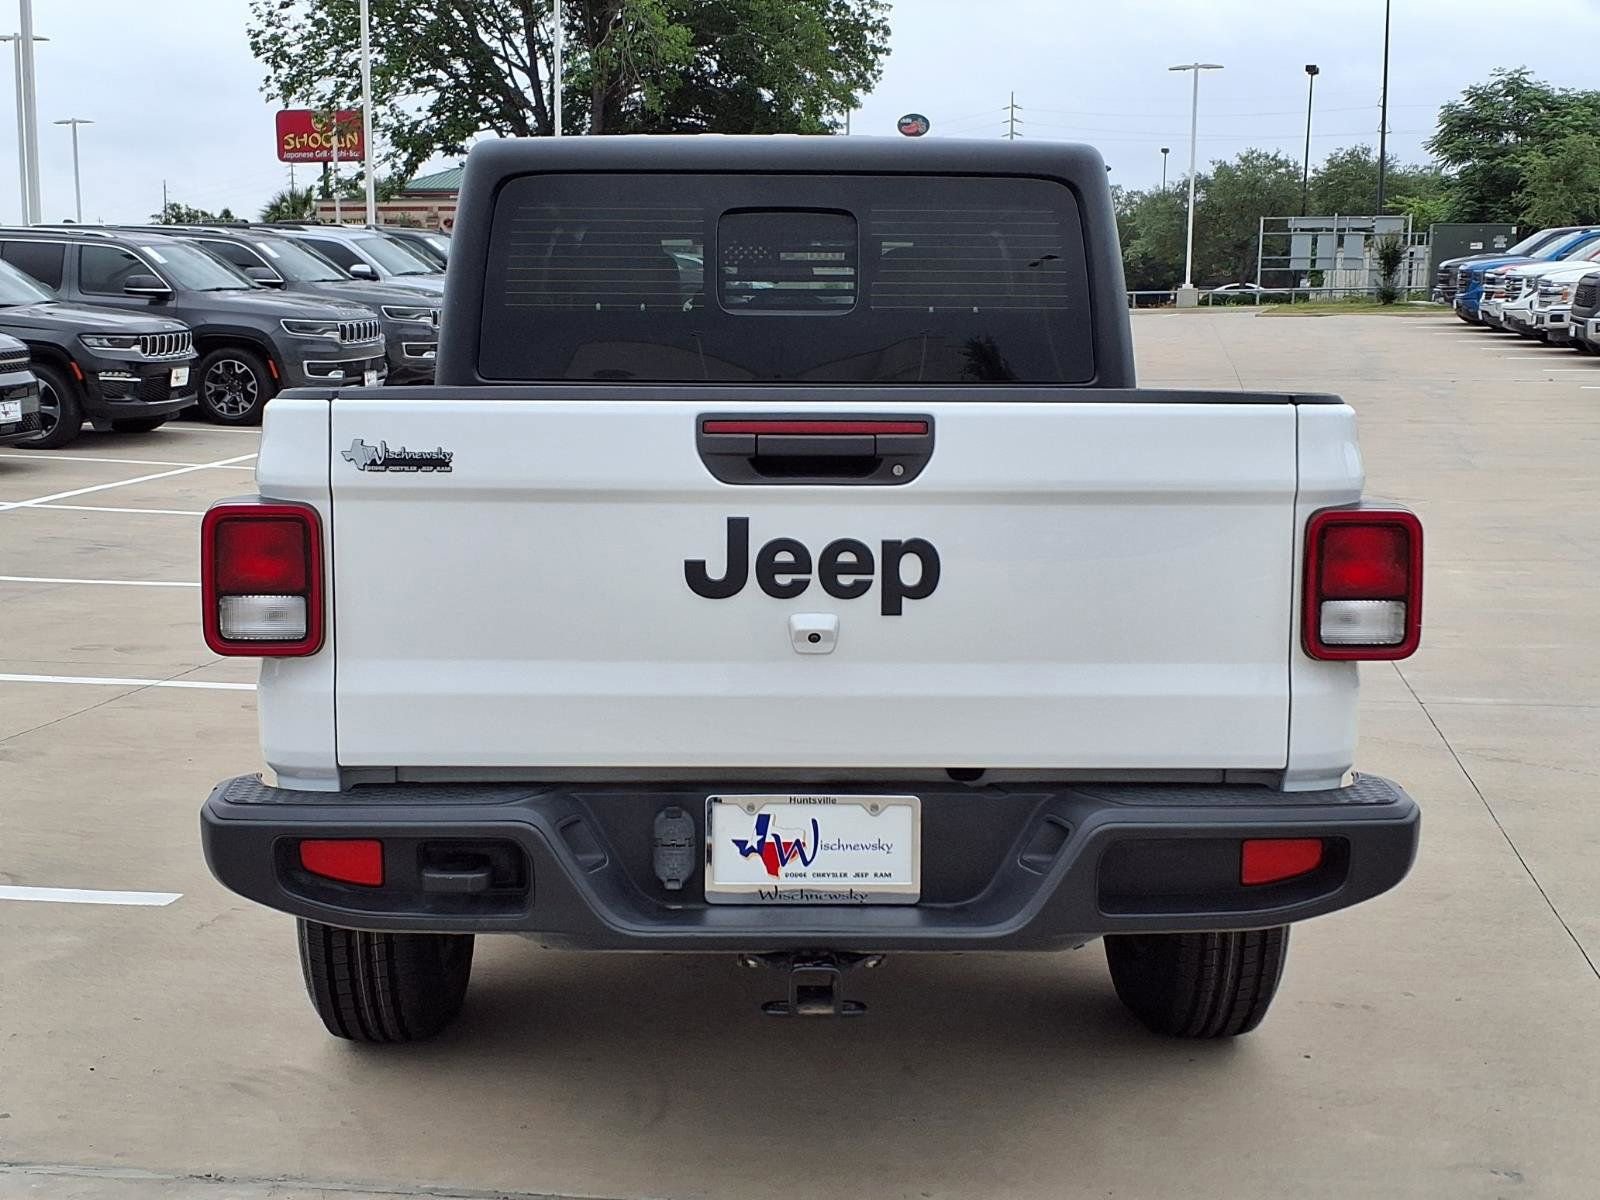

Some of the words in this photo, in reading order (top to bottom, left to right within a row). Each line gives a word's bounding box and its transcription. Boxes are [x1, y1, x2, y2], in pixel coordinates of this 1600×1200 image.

[362, 440, 453, 464] Wischnewsky
[684, 516, 941, 616] Jeep
[789, 796, 837, 805] Huntsville
[771, 818, 893, 867] Wischnewsky
[758, 885, 868, 903] Wischnewsky
